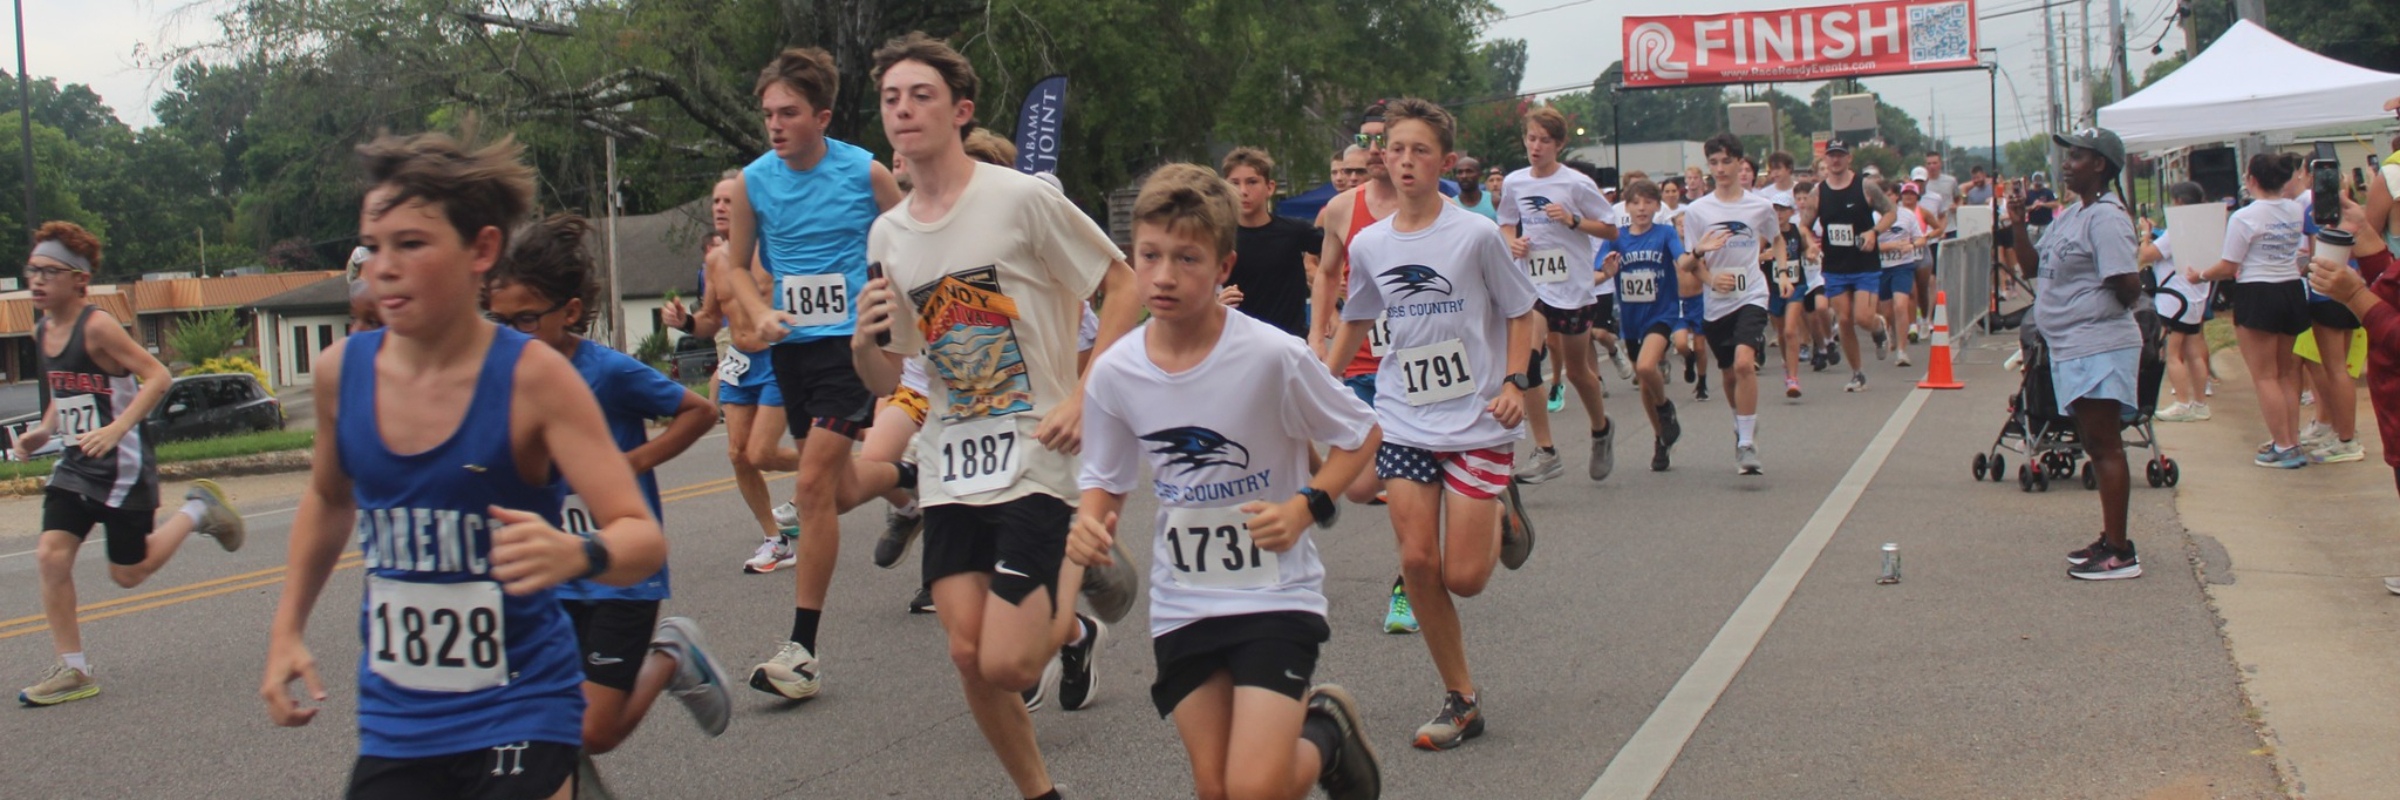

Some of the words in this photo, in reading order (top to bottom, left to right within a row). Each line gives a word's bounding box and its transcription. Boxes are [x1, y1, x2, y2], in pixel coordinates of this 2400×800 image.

[1693, 7, 1900, 66] FINISH
[1038, 89, 1057, 160] JOINT
[1829, 230, 1852, 240] 1861
[1529, 256, 1567, 276] 1744
[786, 285, 845, 315] 1845
[1409, 299, 1464, 316] COUNTRY
[1403, 352, 1470, 393] 1791
[943, 431, 1015, 482] 1887
[1184, 469, 1270, 502] COUNTRY
[376, 602, 500, 669] 1828
